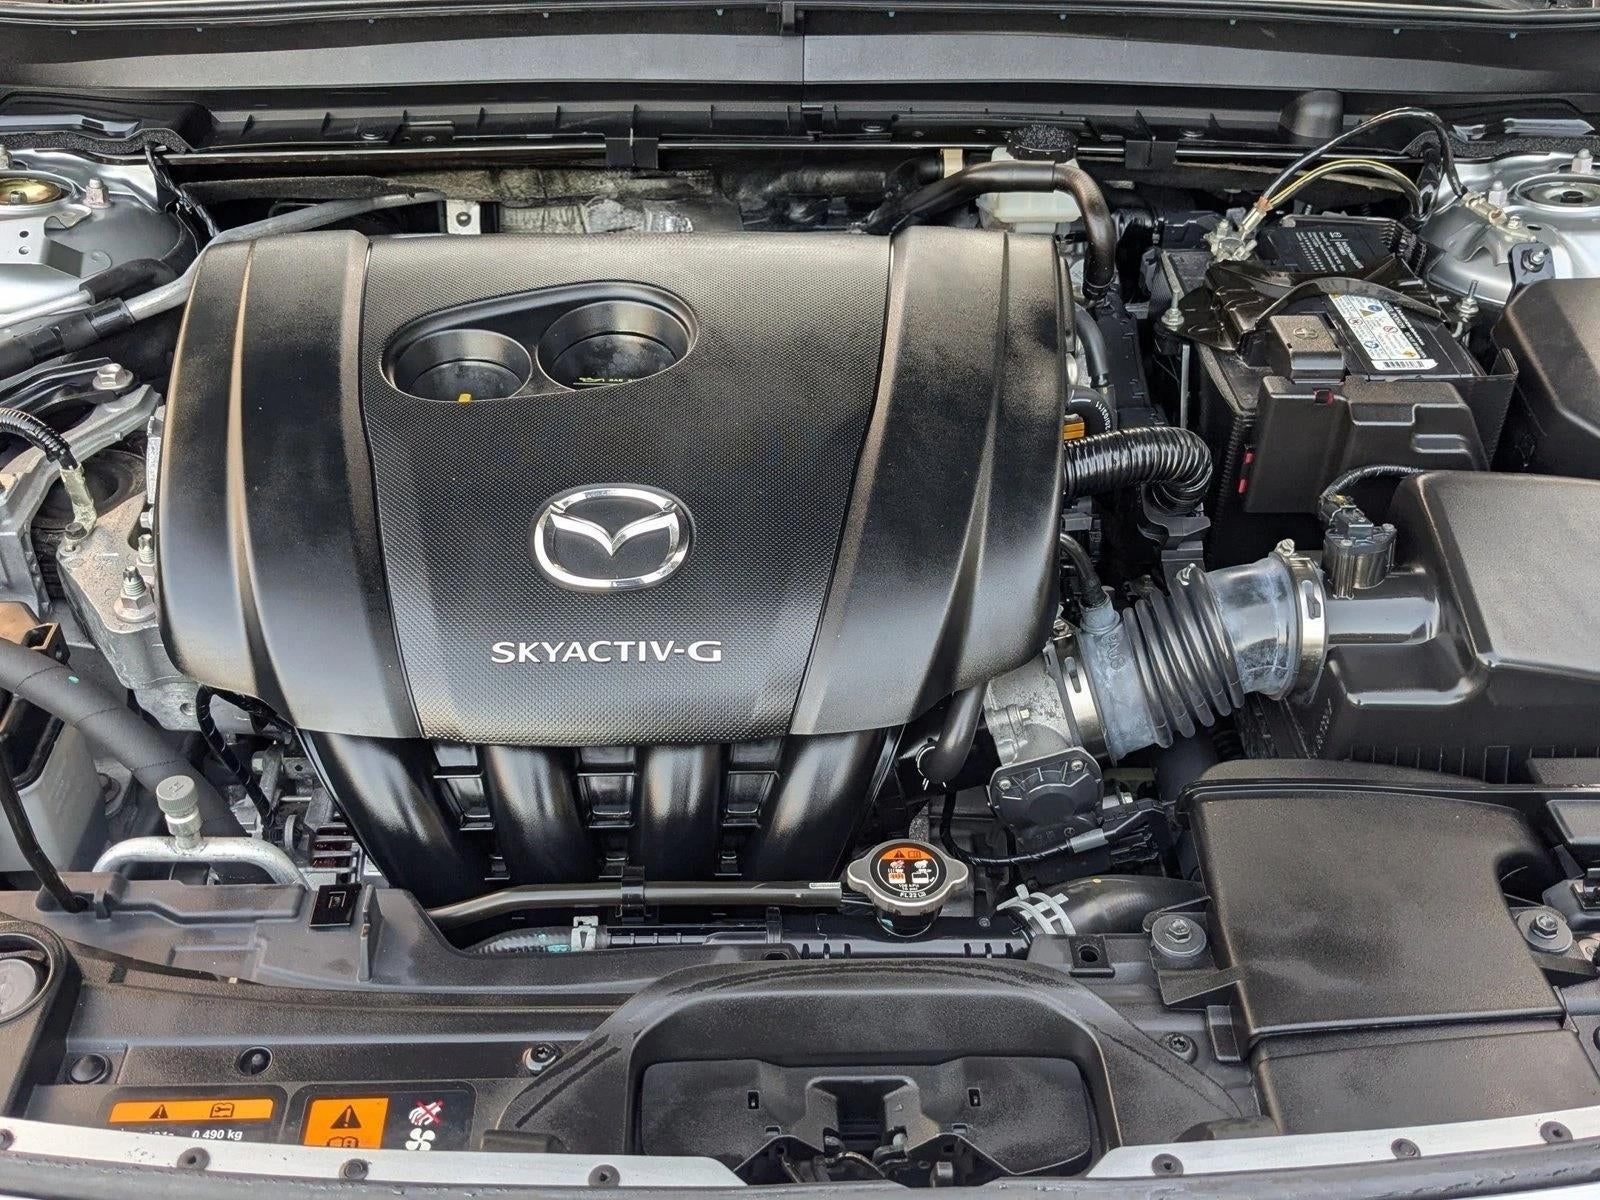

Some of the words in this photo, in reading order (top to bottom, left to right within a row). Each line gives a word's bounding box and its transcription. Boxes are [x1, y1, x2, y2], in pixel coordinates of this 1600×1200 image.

[491, 640, 722, 664] SKYACTIV-G
[192, 1129, 224, 1140] 0490
[227, 1129, 243, 1141] kg
